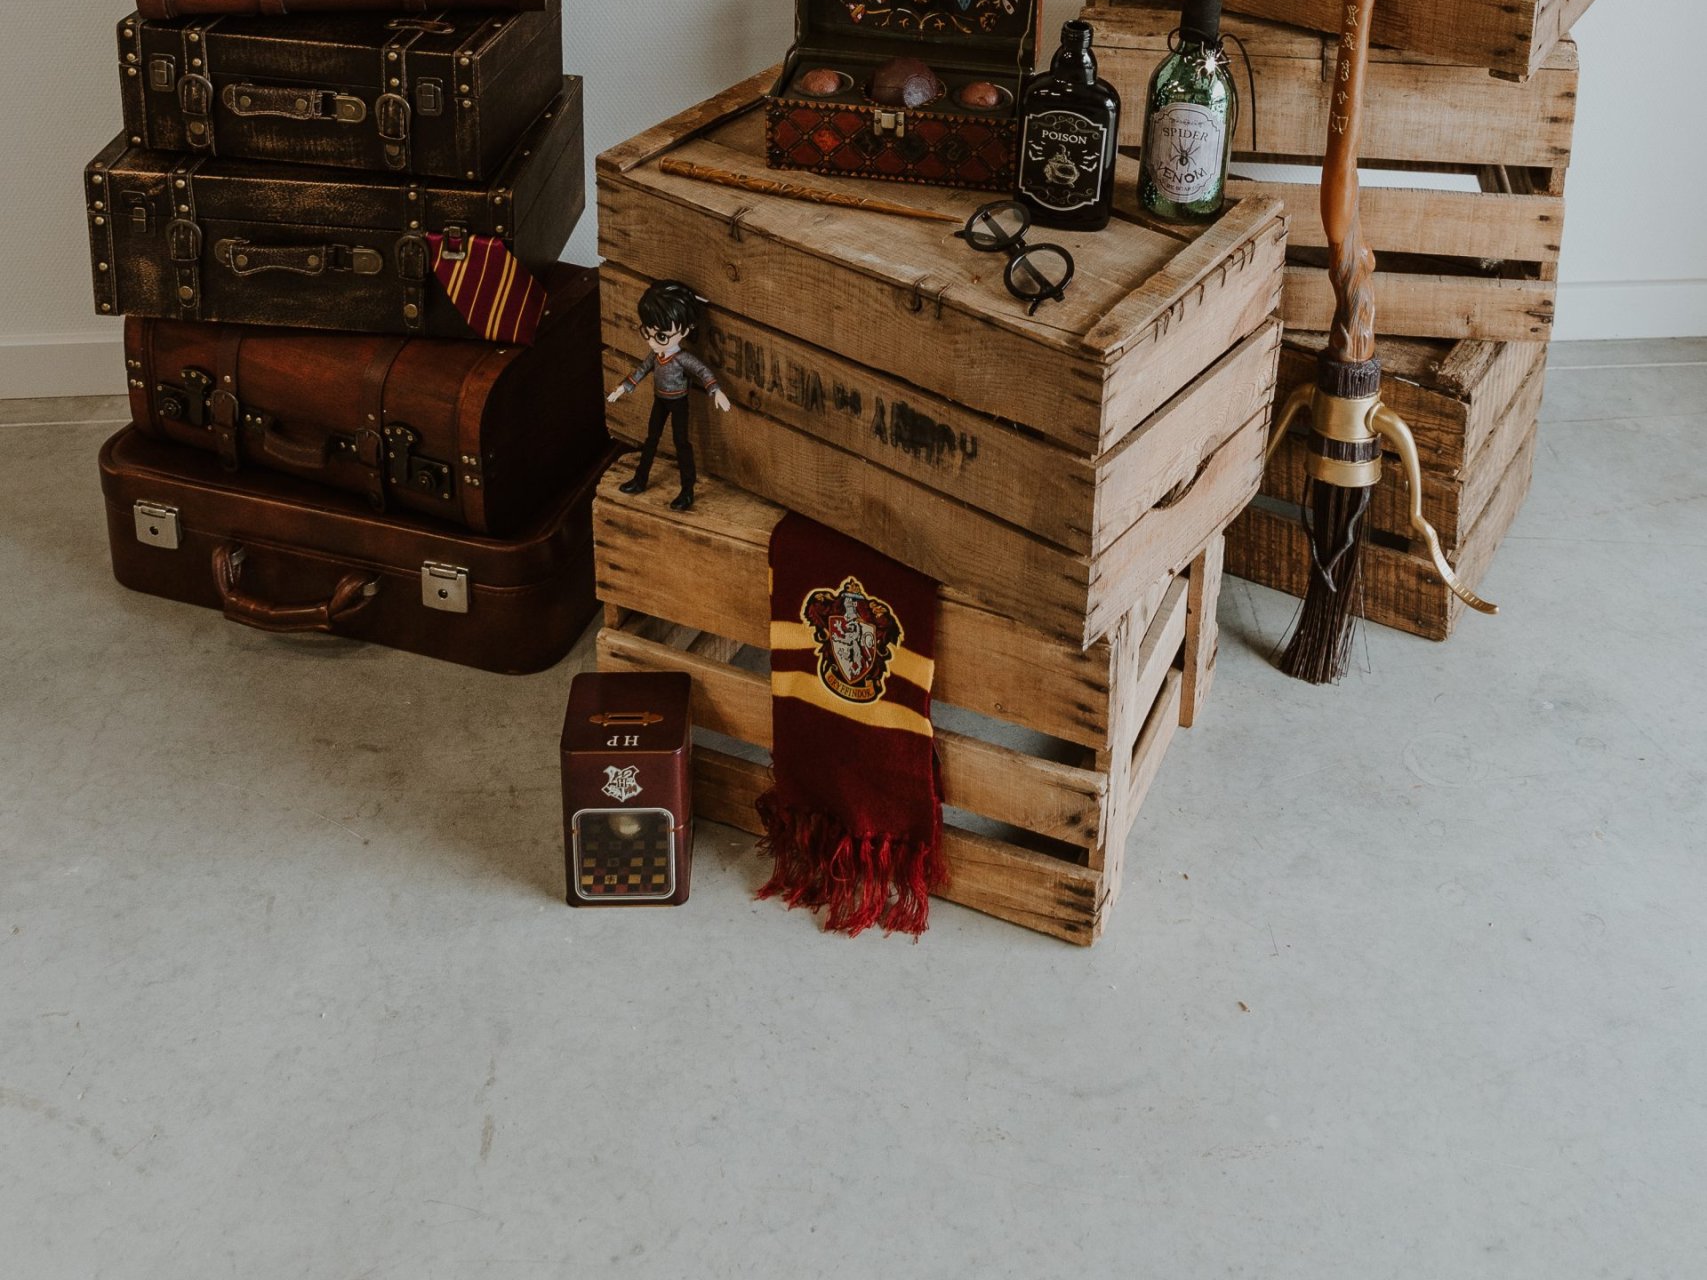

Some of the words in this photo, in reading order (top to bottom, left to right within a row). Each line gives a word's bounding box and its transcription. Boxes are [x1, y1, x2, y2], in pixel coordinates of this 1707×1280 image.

[1041, 128, 1088, 146] POISON
[1162, 126, 1209, 143] SPIDER
[1156, 161, 1208, 185] VENOM
[827, 674, 871, 698] GRYFFINDOR
